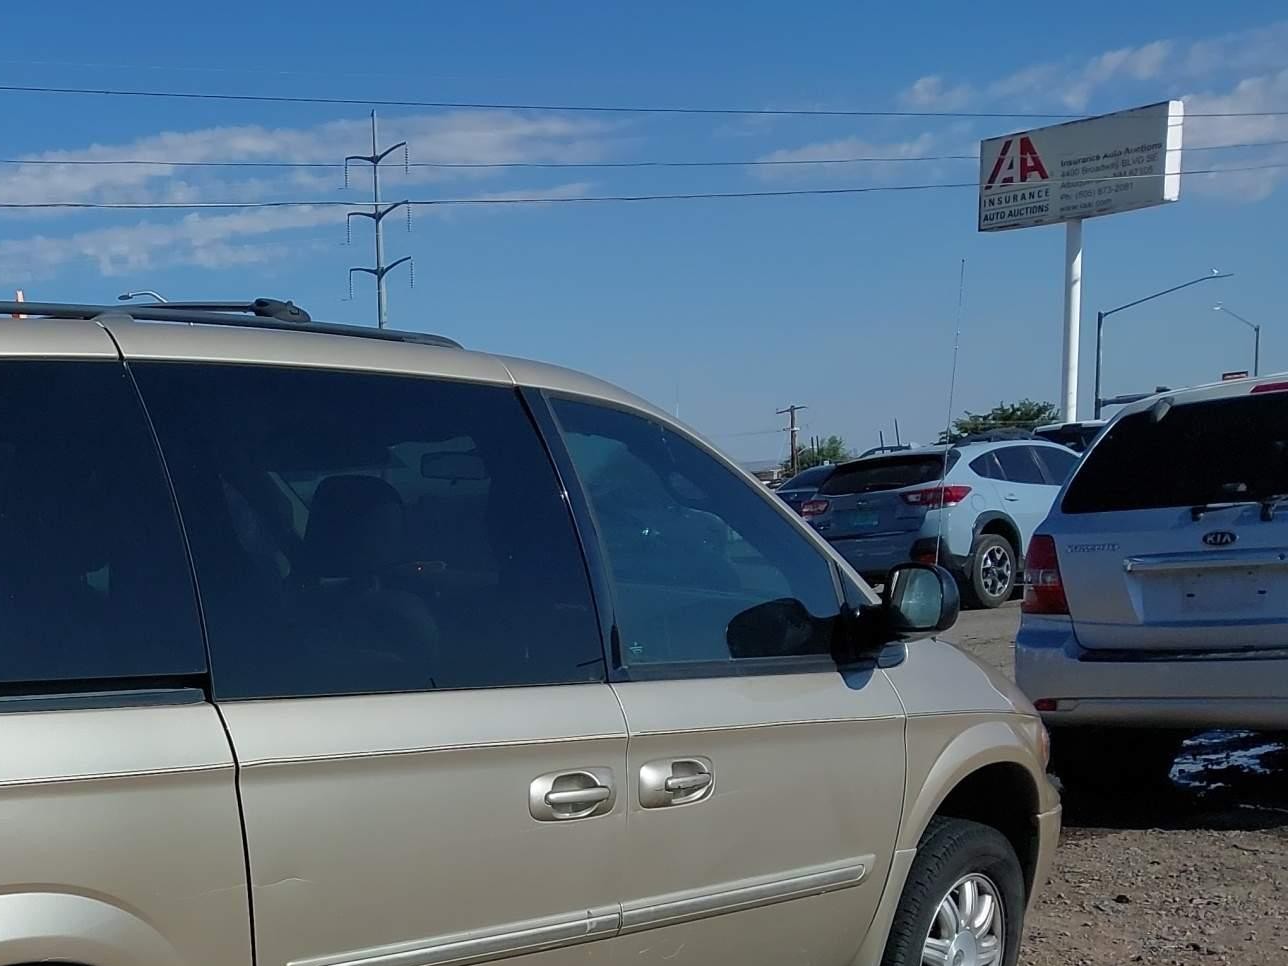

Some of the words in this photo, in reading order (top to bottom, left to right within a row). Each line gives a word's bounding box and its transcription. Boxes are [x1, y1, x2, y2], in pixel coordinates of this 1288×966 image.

[1061, 155, 1101, 167] Insurance
[1103, 150, 1122, 160] Auto
[1124, 142, 1163, 155] Auctions
[983, 188, 1050, 208] INSURANCE
[983, 211, 1005, 223] AUTO
[1008, 204, 1049, 218] AUCTIONS
[1206, 533, 1232, 543] KIA
